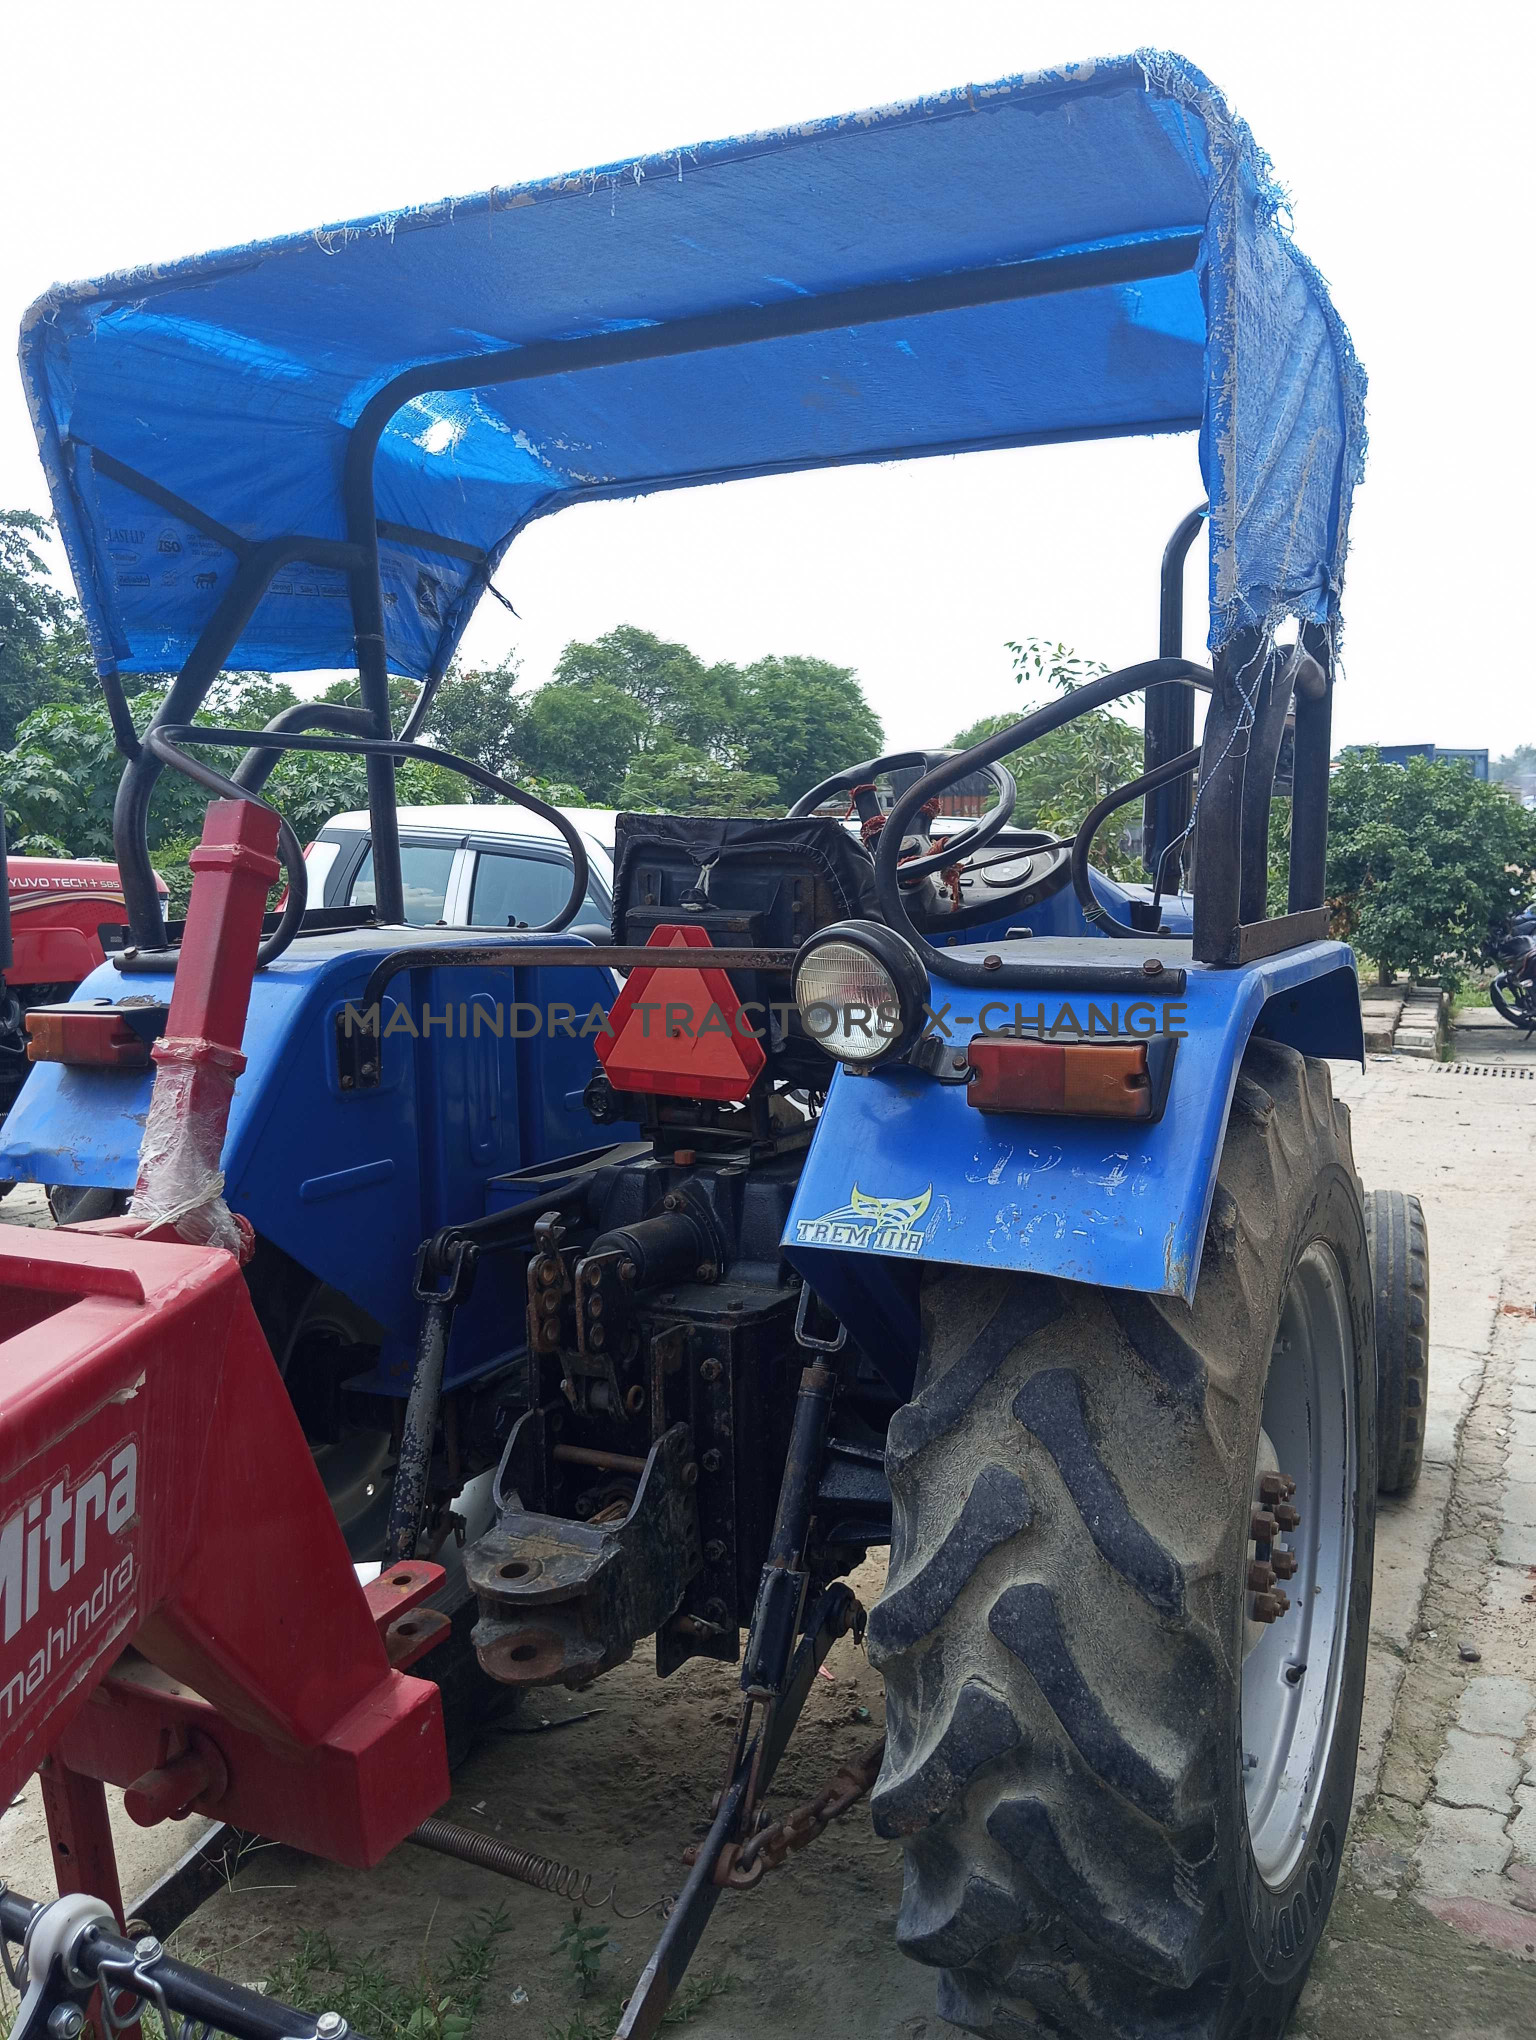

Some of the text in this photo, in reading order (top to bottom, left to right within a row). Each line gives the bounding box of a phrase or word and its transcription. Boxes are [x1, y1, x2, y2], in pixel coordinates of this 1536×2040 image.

[158, 540, 181, 553] ISO
[9, 878, 50, 888] YUVO
[52, 878, 88, 888] TECH
[798, 1222, 870, 1247] TREM
